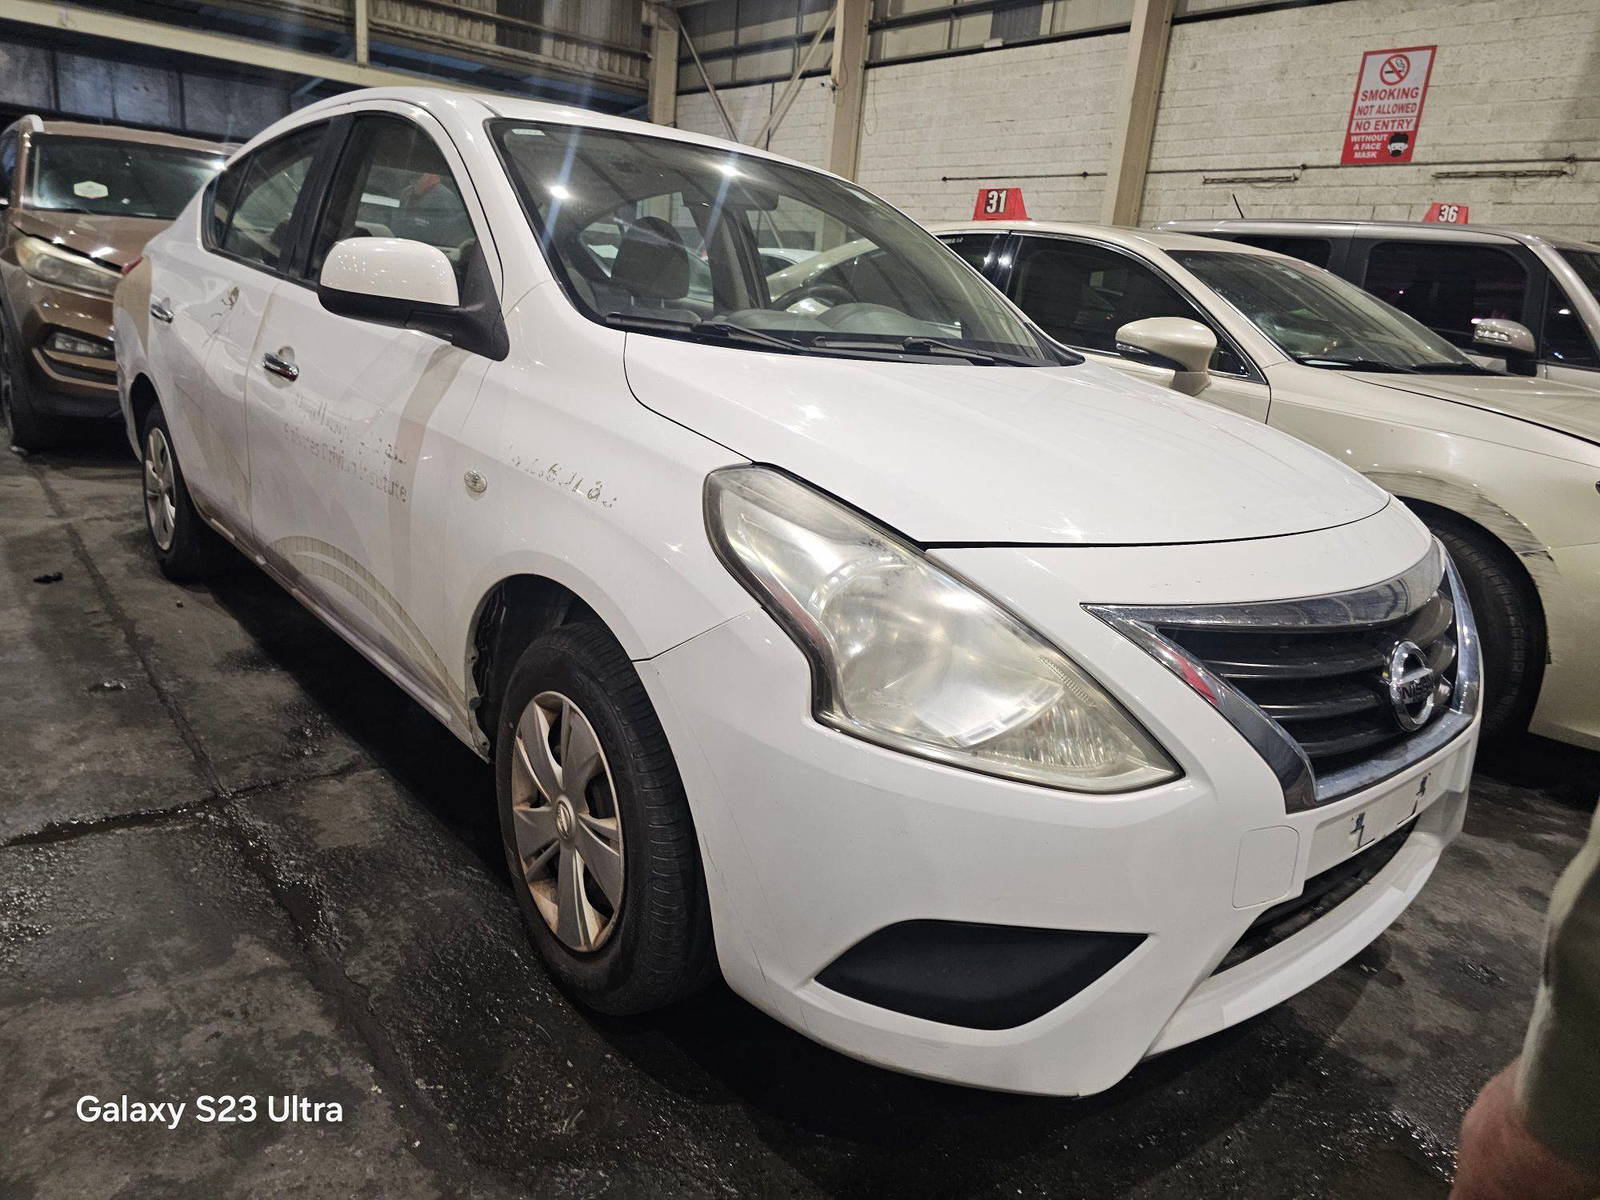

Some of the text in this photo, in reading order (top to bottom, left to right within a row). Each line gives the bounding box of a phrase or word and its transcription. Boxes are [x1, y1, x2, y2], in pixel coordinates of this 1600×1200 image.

[1361, 87, 1419, 101] SMOKING
[1356, 103, 1417, 116] NOT ALLOWED
[1354, 119, 1413, 131] NO ENTRY
[1351, 134, 1388, 142] WITHOUT
[986, 190, 1007, 213] 31
[1439, 205, 1459, 223] 36
